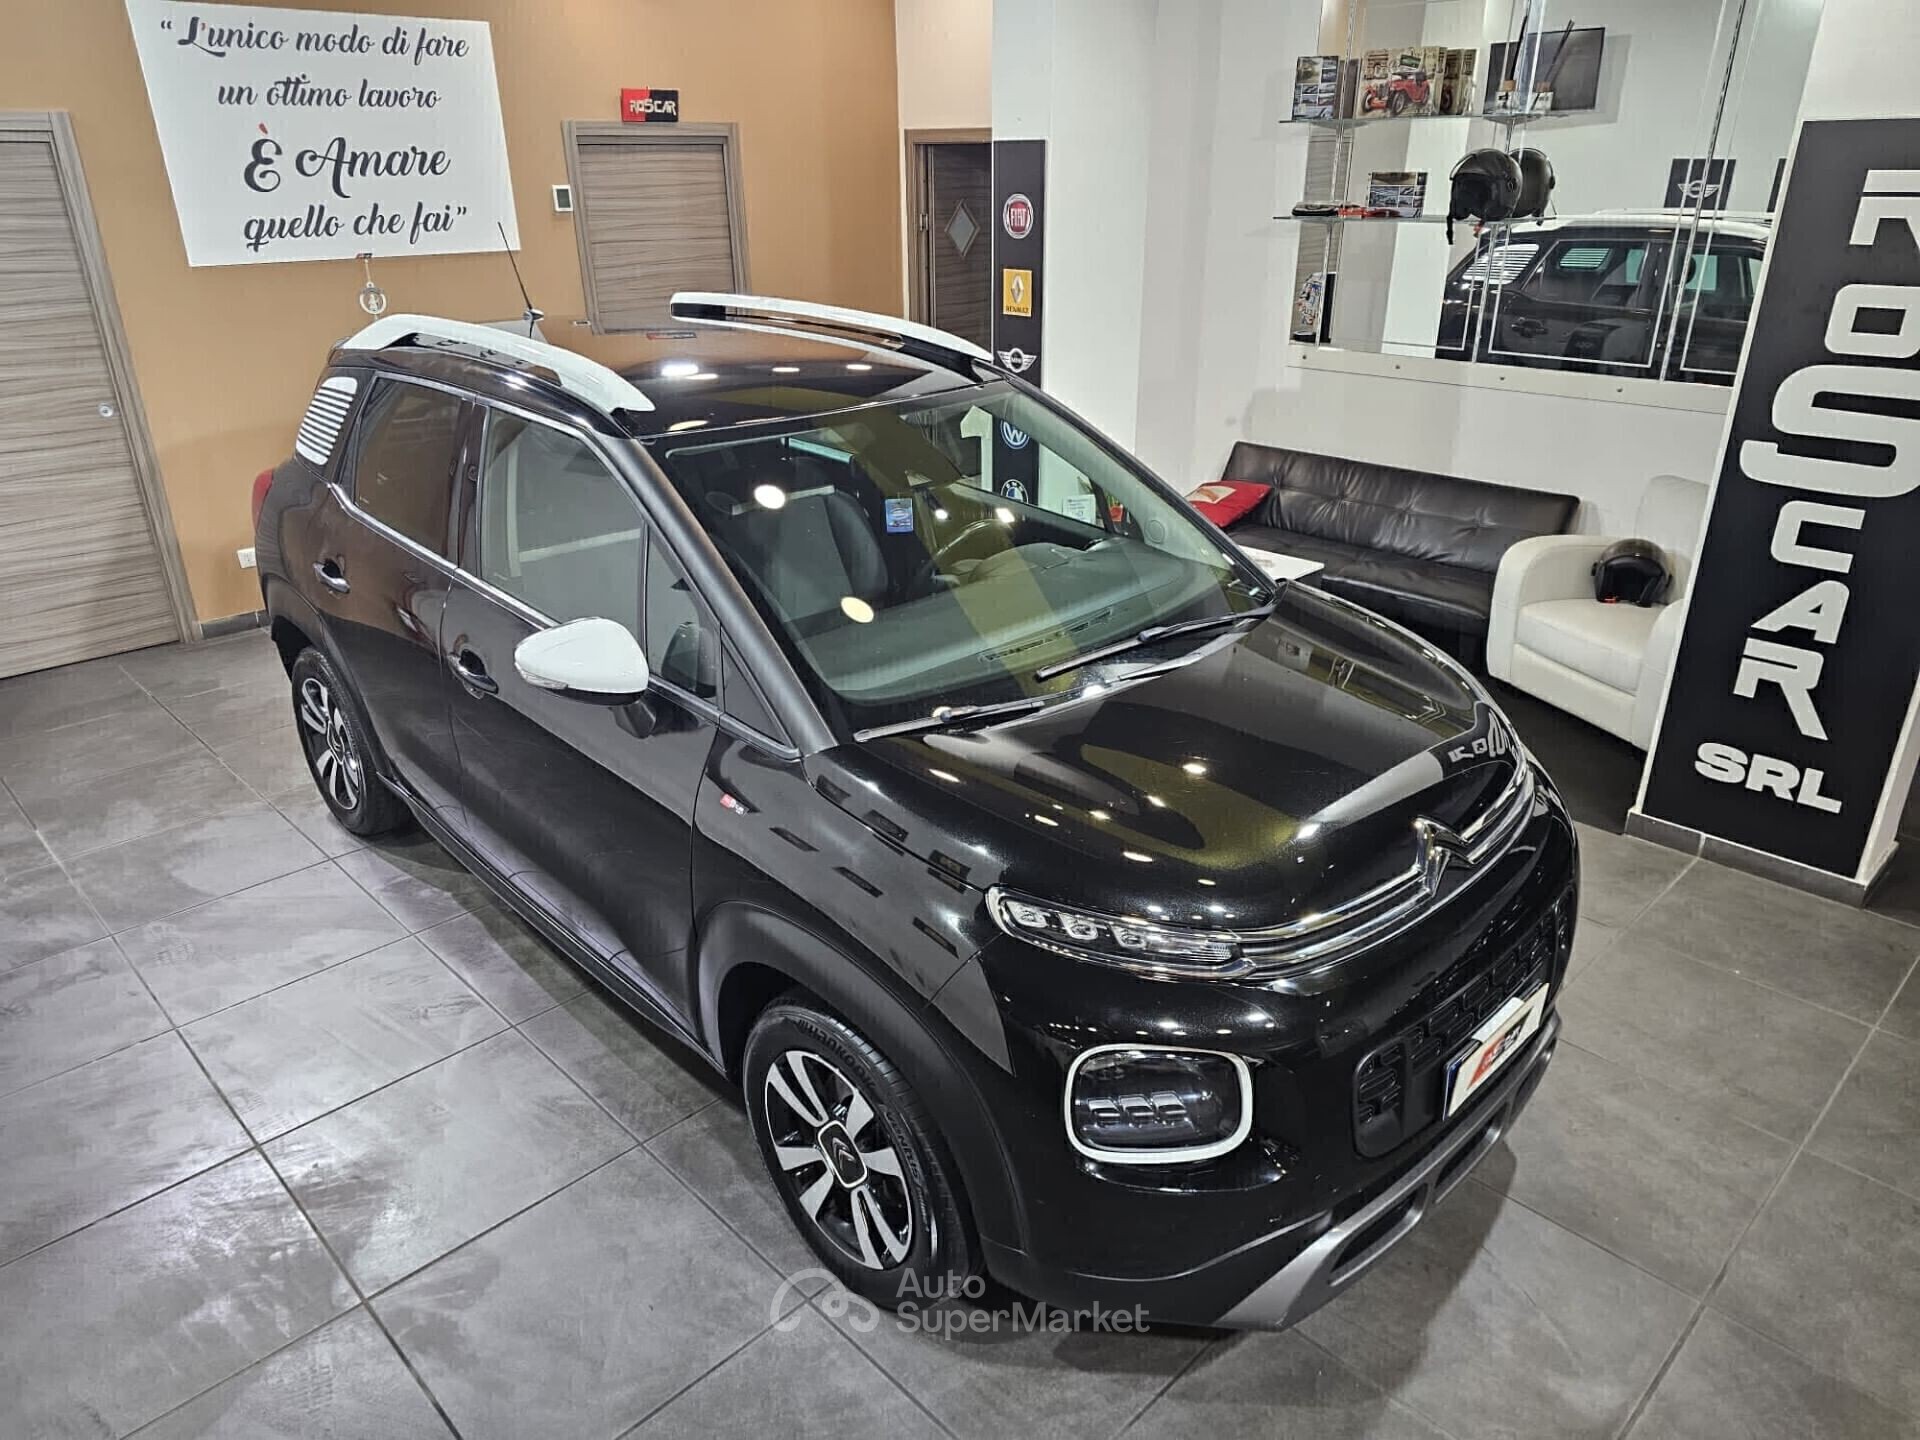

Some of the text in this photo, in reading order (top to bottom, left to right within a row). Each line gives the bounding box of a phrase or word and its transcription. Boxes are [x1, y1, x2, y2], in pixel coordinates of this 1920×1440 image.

[295, 24, 376, 54] modo
[381, 26, 411, 56] di
[413, 27, 470, 66] fare
[217, 73, 443, 109] un ottimo lavoro
[629, 98, 677, 116] ROSCAR
[243, 123, 452, 199] È Amare
[243, 204, 346, 253] quello
[353, 202, 406, 236] che
[1010, 208, 1027, 228] FIAT
[1694, 742, 1843, 815] SRL
